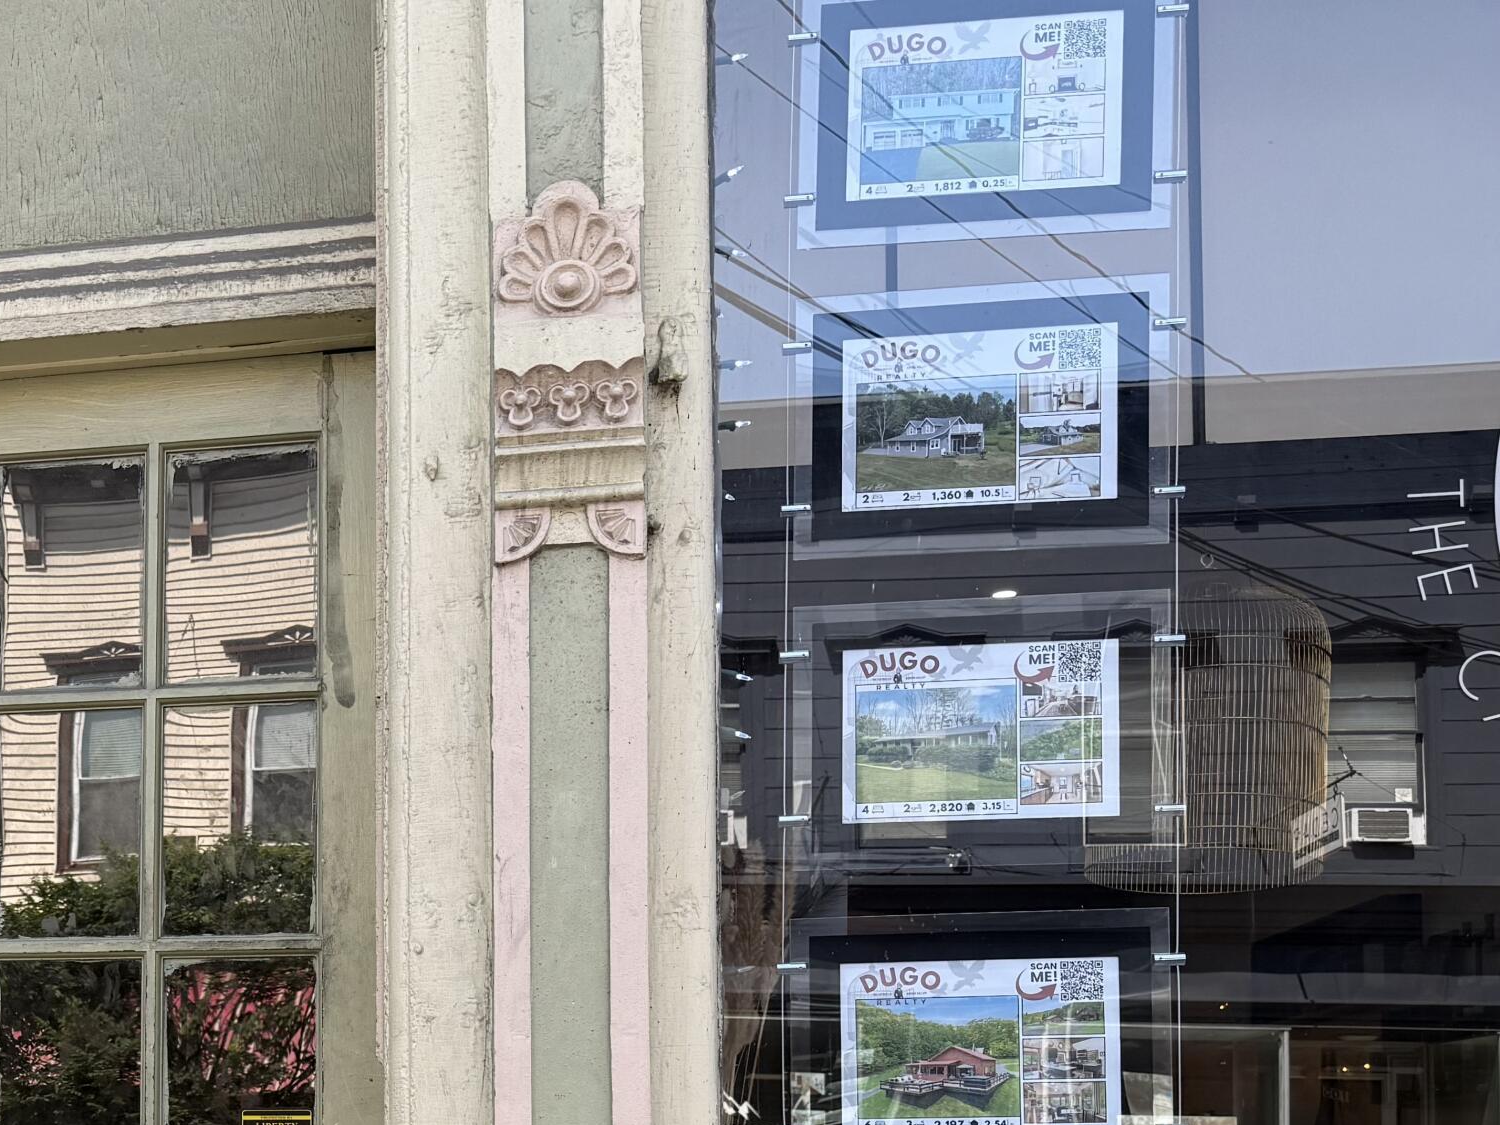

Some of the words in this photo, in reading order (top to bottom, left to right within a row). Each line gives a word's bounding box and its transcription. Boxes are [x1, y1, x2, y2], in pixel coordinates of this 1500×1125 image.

[1034, 22, 1062, 32] SCAN
[1034, 31, 1062, 44] ME!
[866, 32, 947, 62] DUGO
[865, 186, 873, 195] 4
[906, 184, 914, 193] 2
[934, 181, 963, 192] 1,812
[982, 178, 1005, 189] 0.25
[1029, 331, 1056, 340] SCAN
[1029, 340, 1057, 353] ME!
[861, 340, 941, 369] DUGO
[876, 371, 927, 382] REALTY
[862, 494, 870, 504] 2
[903, 492, 910, 502] 2
[932, 490, 962, 502] 1,360
[980, 488, 1001, 498] 10.5
[1406, 478, 1479, 601] THE
[1028, 644, 1055, 653] SCAN
[859, 651, 940, 680] DUGO
[1028, 653, 1056, 665] ME!
[876, 682, 926, 691] REALTY
[862, 805, 870, 815] 4
[903, 803, 911, 813] 2
[929, 802, 963, 814] 2,820
[982, 801, 1002, 811] 3.15
[1030, 962, 1057, 971] SCAN
[859, 966, 941, 994] DUGO
[1030, 970, 1058, 983] ME!
